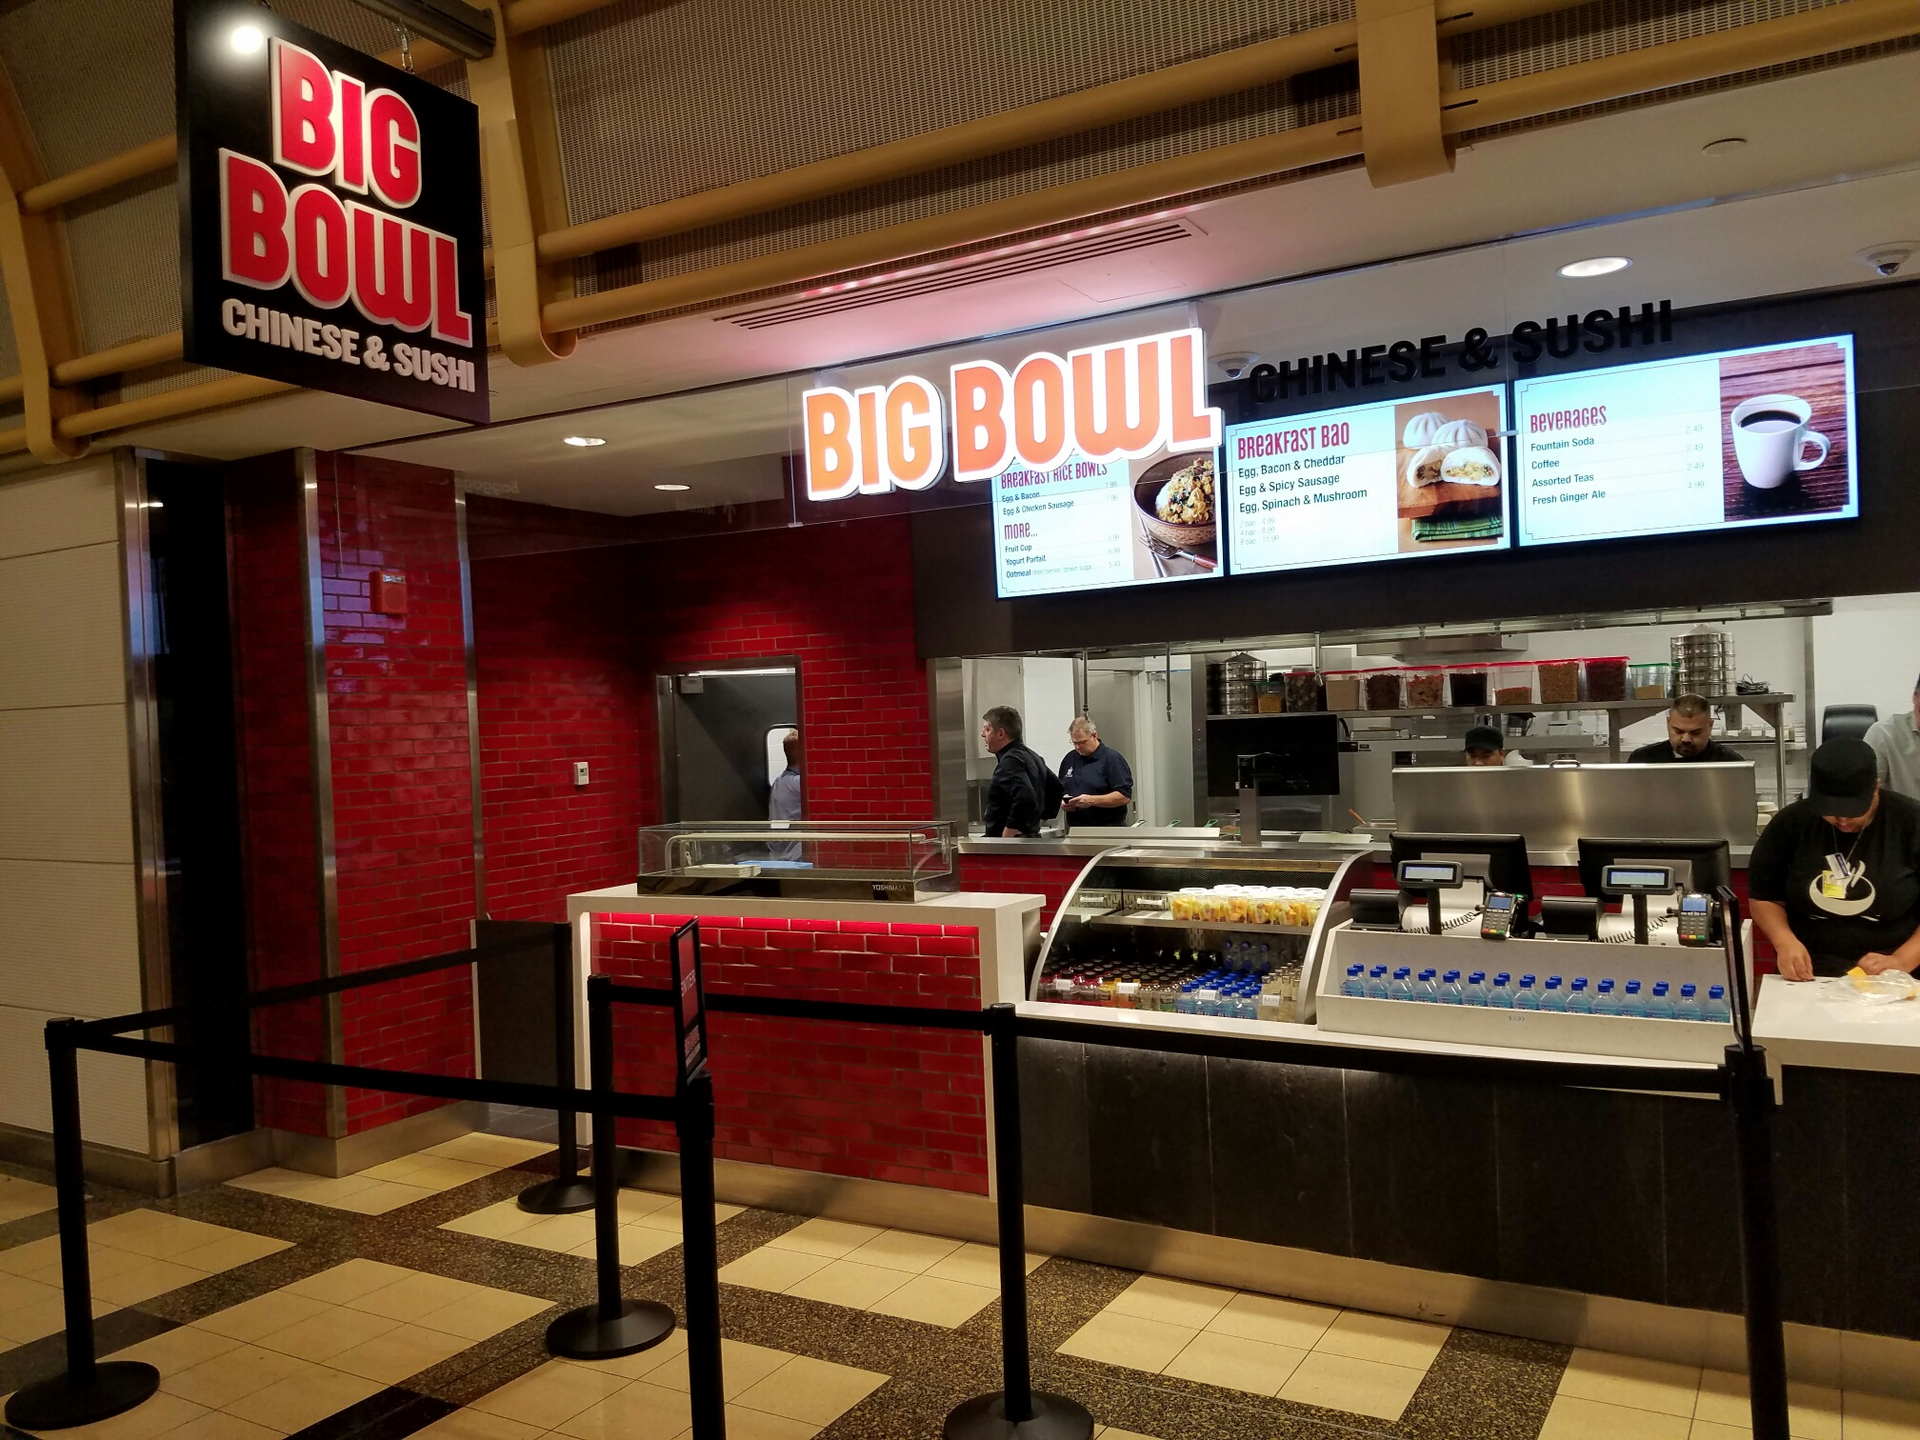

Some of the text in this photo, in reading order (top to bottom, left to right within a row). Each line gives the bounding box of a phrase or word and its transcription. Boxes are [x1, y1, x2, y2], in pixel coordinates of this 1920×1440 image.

[270, 36, 421, 209] BIG
[219, 147, 473, 347] BOWL
[222, 299, 476, 393] CHINESE & SUSHI
[1249, 299, 1673, 402] CHINESE & SUSHI
[802, 326, 1223, 501] BIG BOWL
[1530, 440, 1569, 452] Fountain
[1571, 437, 1595, 447] Soda
[1053, 463, 1074, 482] RICE
[1075, 461, 1108, 479] BOWLS
[1238, 455, 1346, 479] Egg, Bacon & Cheddar
[1531, 459, 1560, 470] Coffee
[1239, 474, 1340, 496] Egg & Spicy Sausage
[1531, 475, 1571, 487] Assorted
[1574, 473, 1594, 483] Teas
[1002, 495, 1014, 503] Egg
[1021, 491, 1041, 500] Bacon
[1239, 489, 1368, 514] Egg, Spinach & Mushroom
[1532, 494, 1557, 505] Fresh
[1559, 491, 1589, 503] Ginger
[1591, 490, 1606, 499] Ale
[1003, 507, 1014, 516] Egg
[1015, 506, 1021, 514] &
[1021, 503, 1047, 513] Chicken
[1047, 500, 1075, 511] Sausage
[1005, 545, 1019, 553] Fruit
[1020, 544, 1033, 553] Cup
[1005, 557, 1025, 566] Yogurt
[1025, 555, 1046, 563] Parfait
[1006, 569, 1032, 578] Oatmeal
[1079, 564, 1093, 572] sugar
